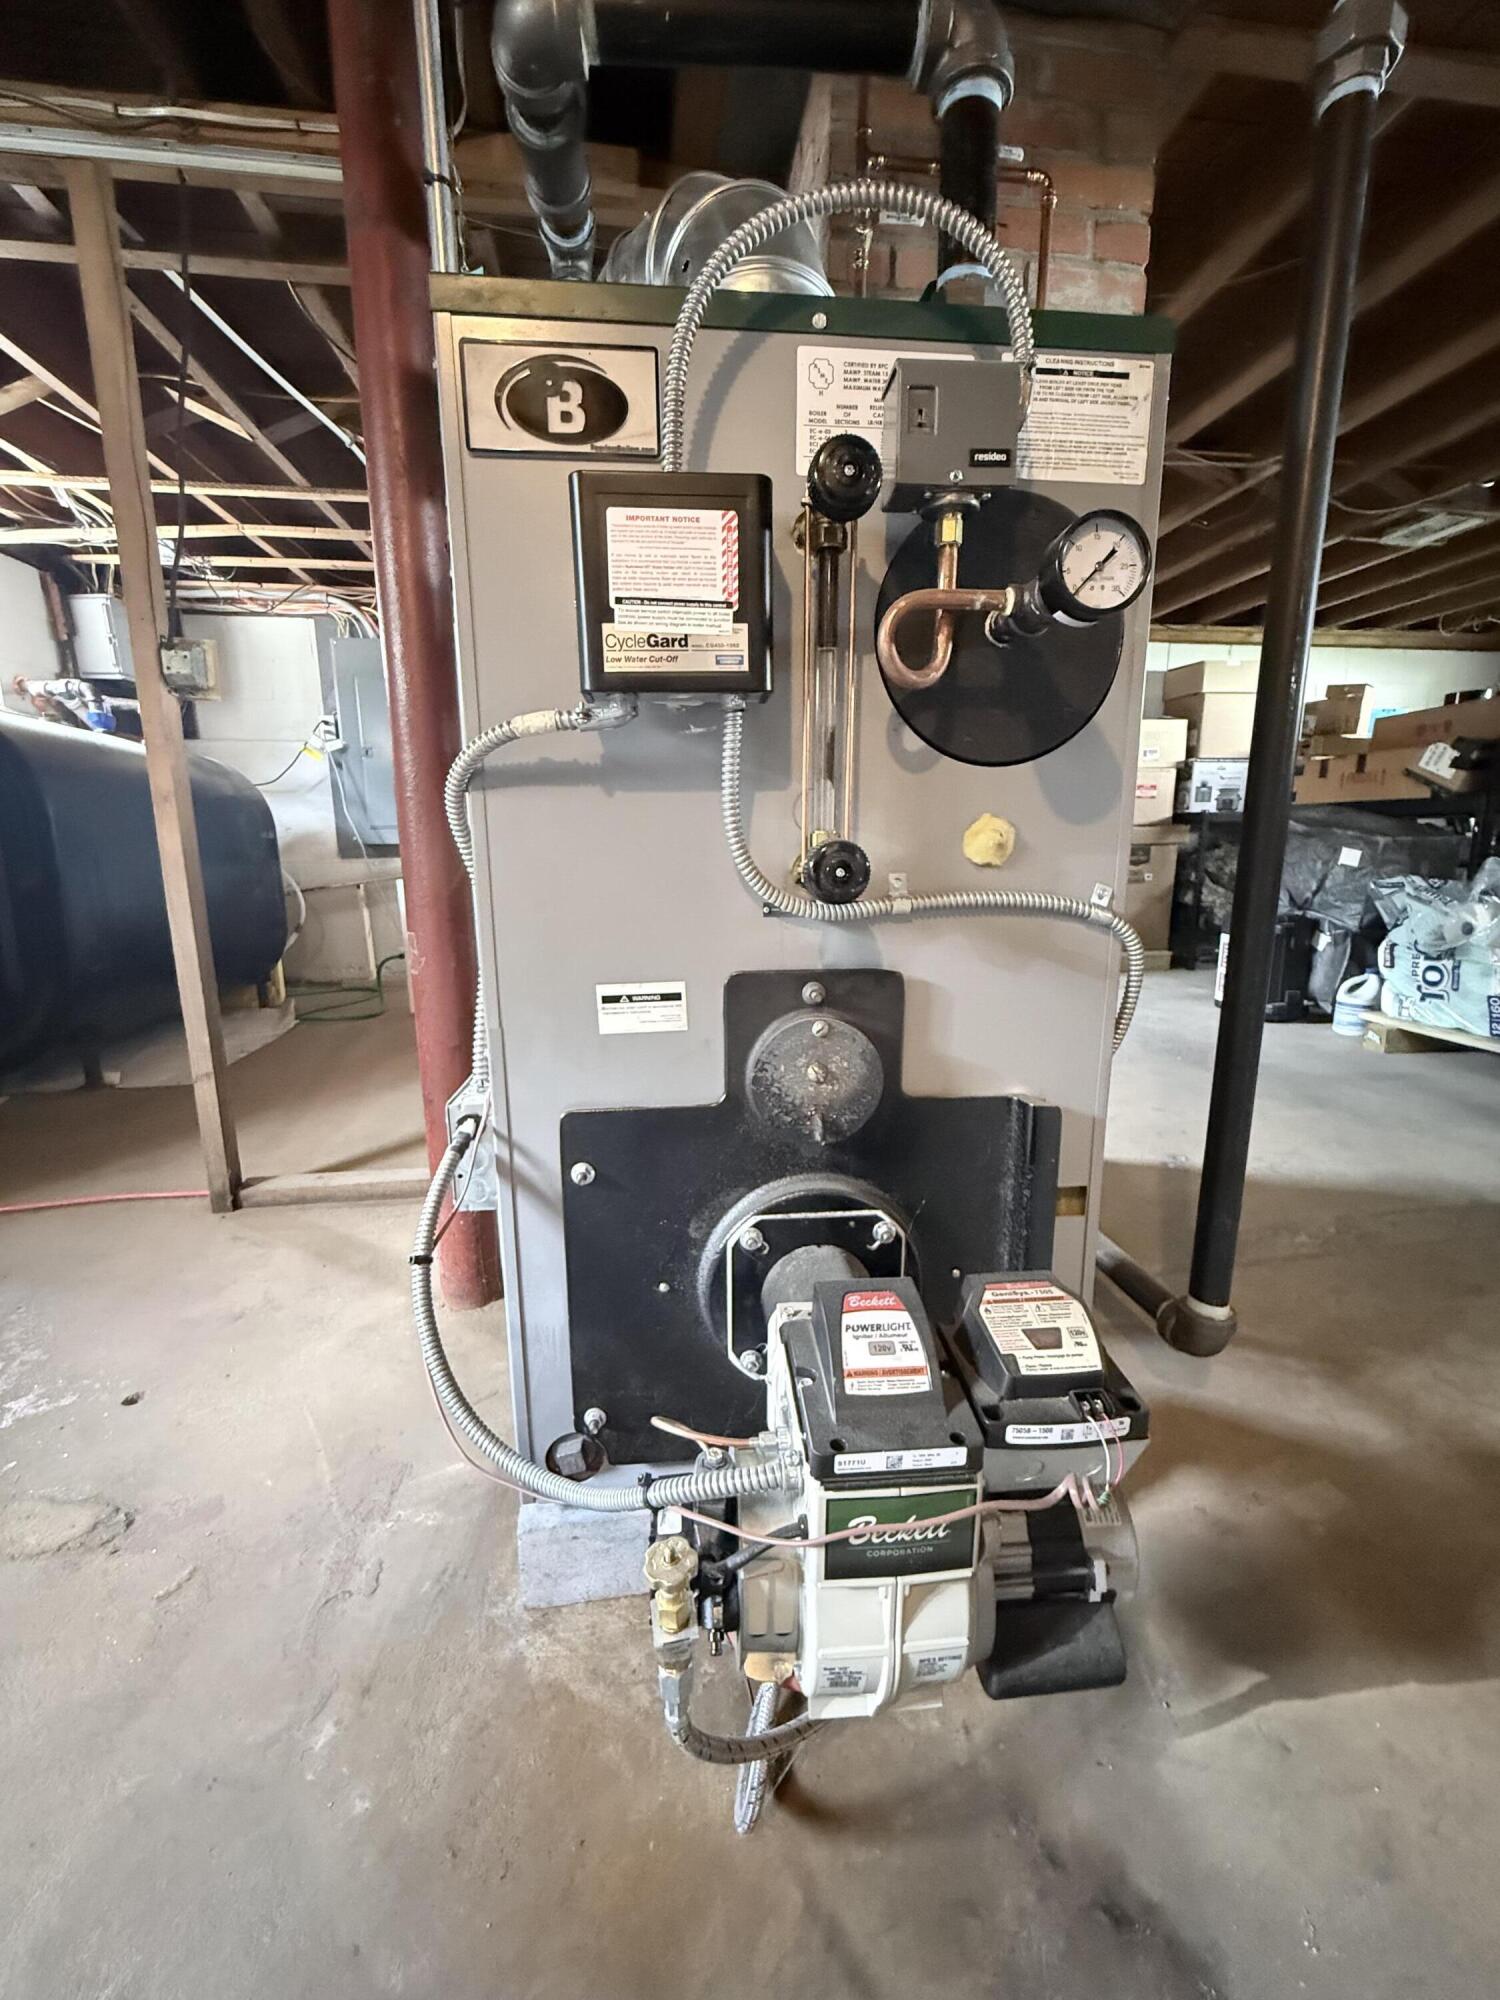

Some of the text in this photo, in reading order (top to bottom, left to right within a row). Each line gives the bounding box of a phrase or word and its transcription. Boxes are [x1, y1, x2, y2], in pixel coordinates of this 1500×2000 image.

[974, 452, 1007, 461] resideo
[605, 634, 689, 652] CycleGard
[848, 1295, 896, 1308] Beckett
[845, 1322, 912, 1333] POWERLIGHT
[866, 1546, 933, 1557] CORPORATION
